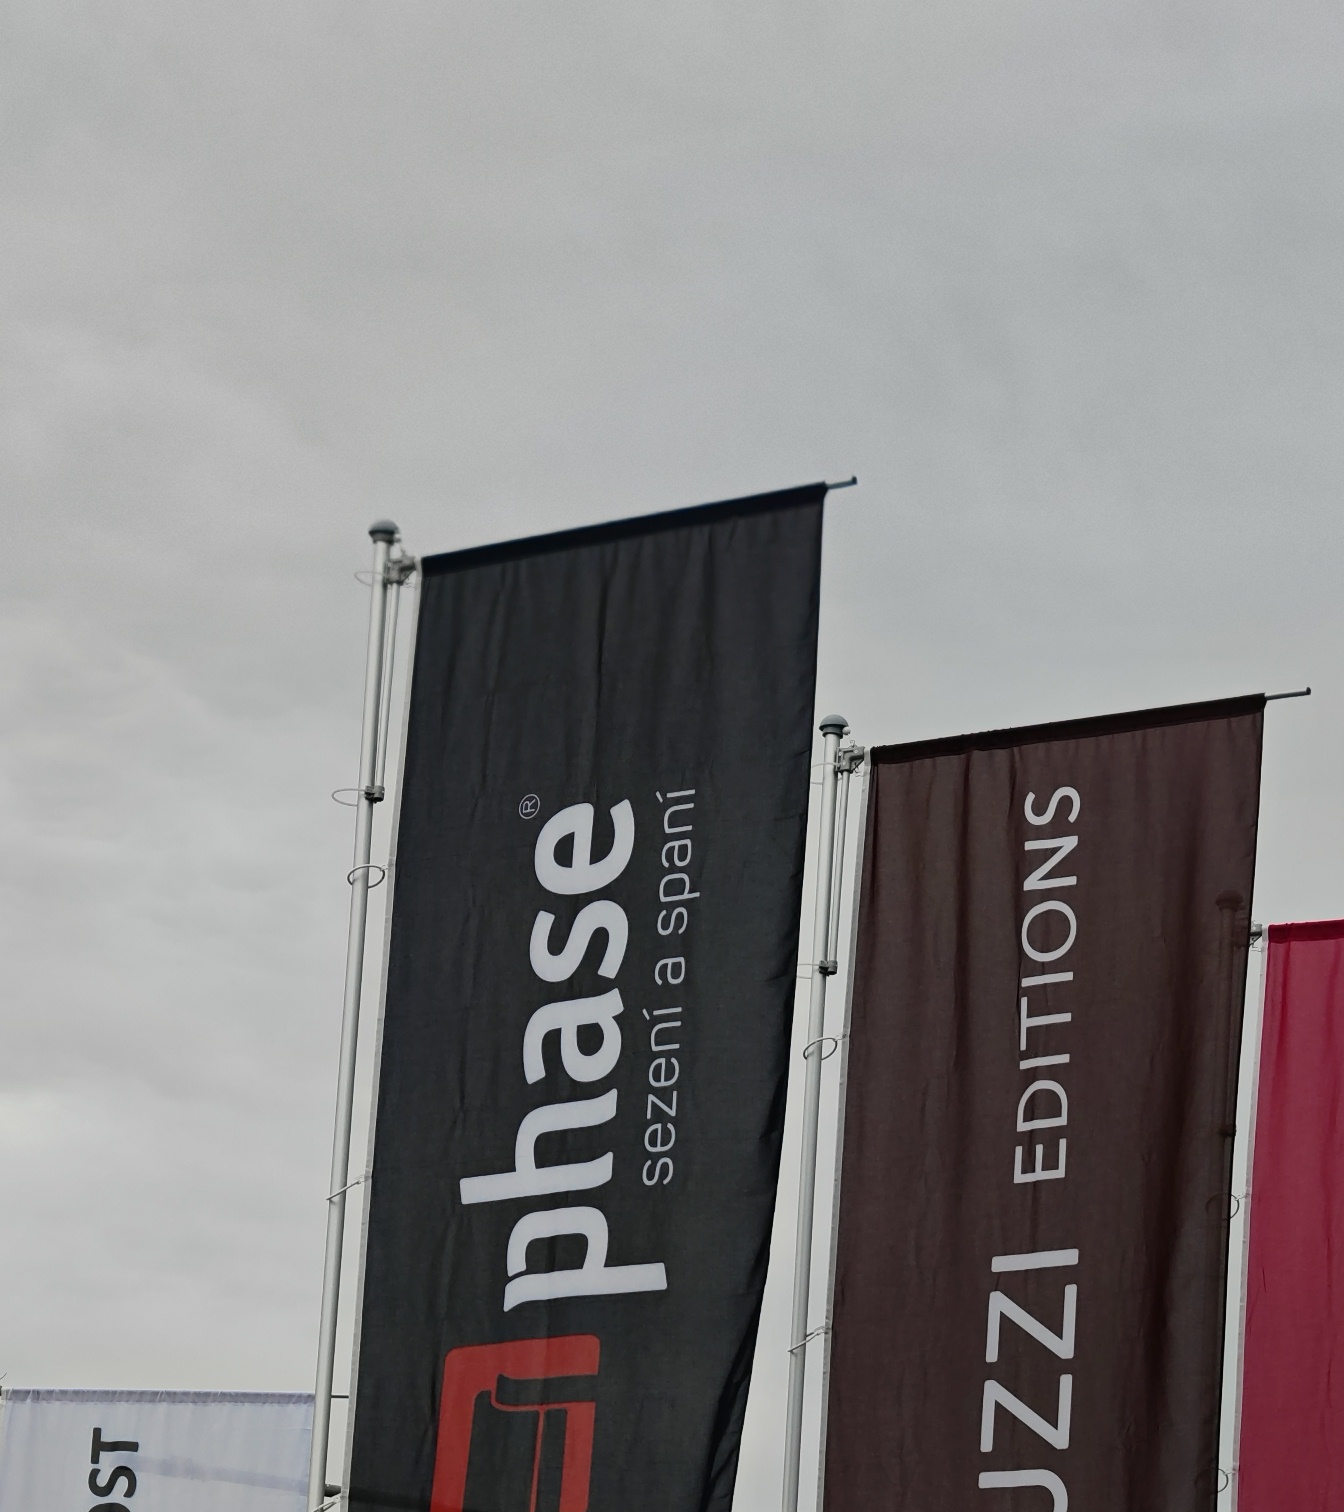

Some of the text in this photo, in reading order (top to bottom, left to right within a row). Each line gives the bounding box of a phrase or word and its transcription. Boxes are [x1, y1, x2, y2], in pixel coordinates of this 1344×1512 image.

[459, 798, 668, 1313] phase
[642, 788, 701, 1186] sezení a spaní
[1013, 786, 1081, 1184] EDITIONS
